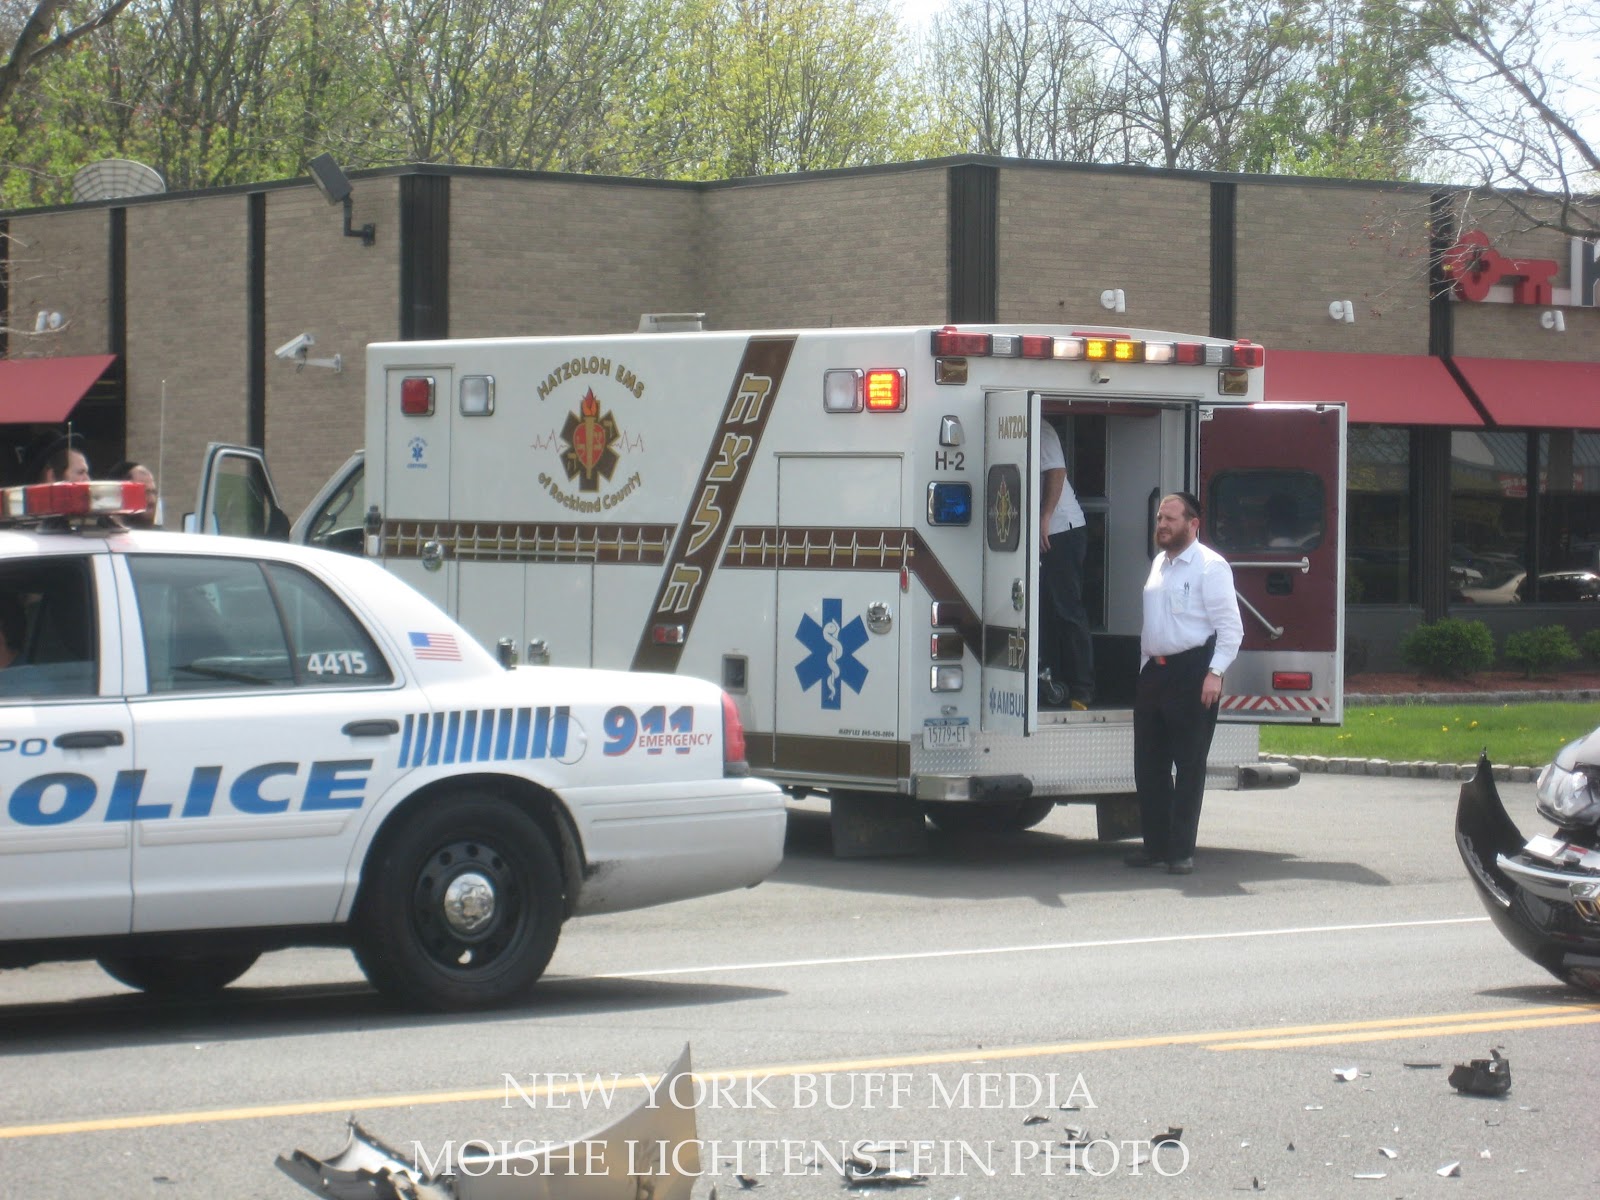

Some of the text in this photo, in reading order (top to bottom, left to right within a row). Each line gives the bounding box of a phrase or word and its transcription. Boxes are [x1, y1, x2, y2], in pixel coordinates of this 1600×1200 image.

[536, 356, 645, 401] HATZOLOH EMS
[935, 451, 965, 471] H-2
[550, 482, 601, 514] Rockland
[602, 471, 643, 509] County
[657, 373, 773, 614] הצלה
[307, 652, 368, 675] 4415
[603, 705, 695, 757] 911
[638, 734, 713, 748] EMERGENCY
[7, 758, 375, 827] OLICE
